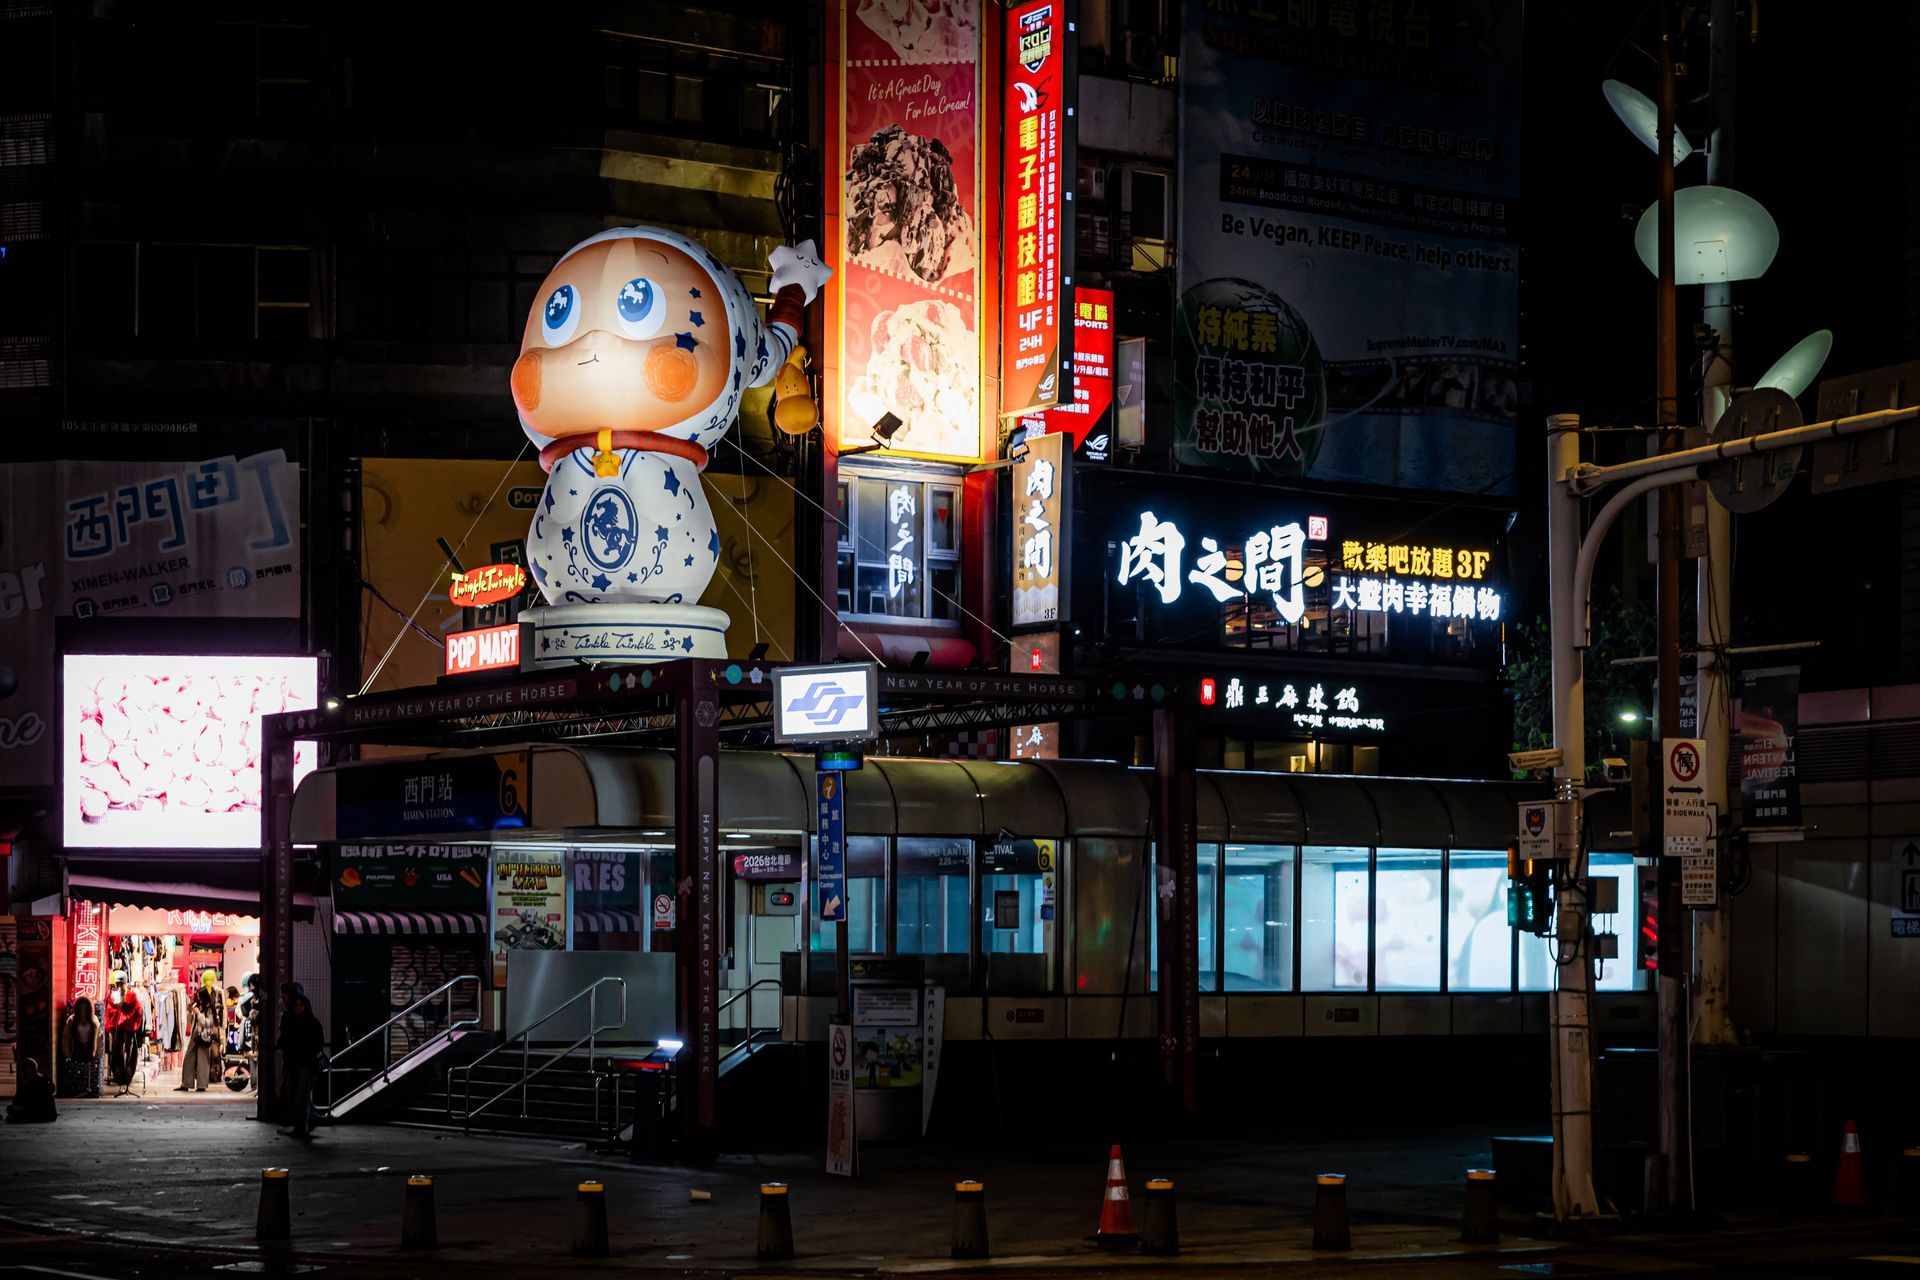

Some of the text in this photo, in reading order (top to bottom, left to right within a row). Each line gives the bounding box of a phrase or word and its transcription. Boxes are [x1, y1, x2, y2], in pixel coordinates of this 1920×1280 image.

[896, 79, 922, 101] Great
[923, 74, 942, 97] Day
[905, 91, 971, 120] For Ice Cream!
[1222, 214, 1515, 273] Be Vegan, KEEP Peace, help others.
[1019, 309, 1043, 332] 4F
[1074, 302, 1108, 321] 電腦
[1019, 334, 1043, 352] 24H
[1195, 355, 1306, 410] 保持和平
[1195, 408, 1304, 461] 幫助他人
[1024, 459, 1054, 580] 肉之間
[1118, 511, 1307, 624] 肉之間
[1342, 540, 1490, 579] 歡樂吧放題 3F
[71, 557, 191, 593] XIMEN-WALKER
[1044, 608, 1057, 620] 3F
[449, 629, 520, 671] POP MART
[886, 676, 1075, 695] NEW YEAR OF THE HORSE
[354, 684, 566, 721] HAPPY NEW YEAR OF THE HORSE
[1677, 751, 1694, 774] 停
[404, 774, 454, 804] 西門站
[500, 769, 518, 816] 6
[403, 807, 455, 821] XIMEN STATION
[1037, 845, 1051, 871] 6
[436, 873, 453, 882] USA
[75, 925, 100, 999] KILLER
[703, 960, 710, 977] OF
